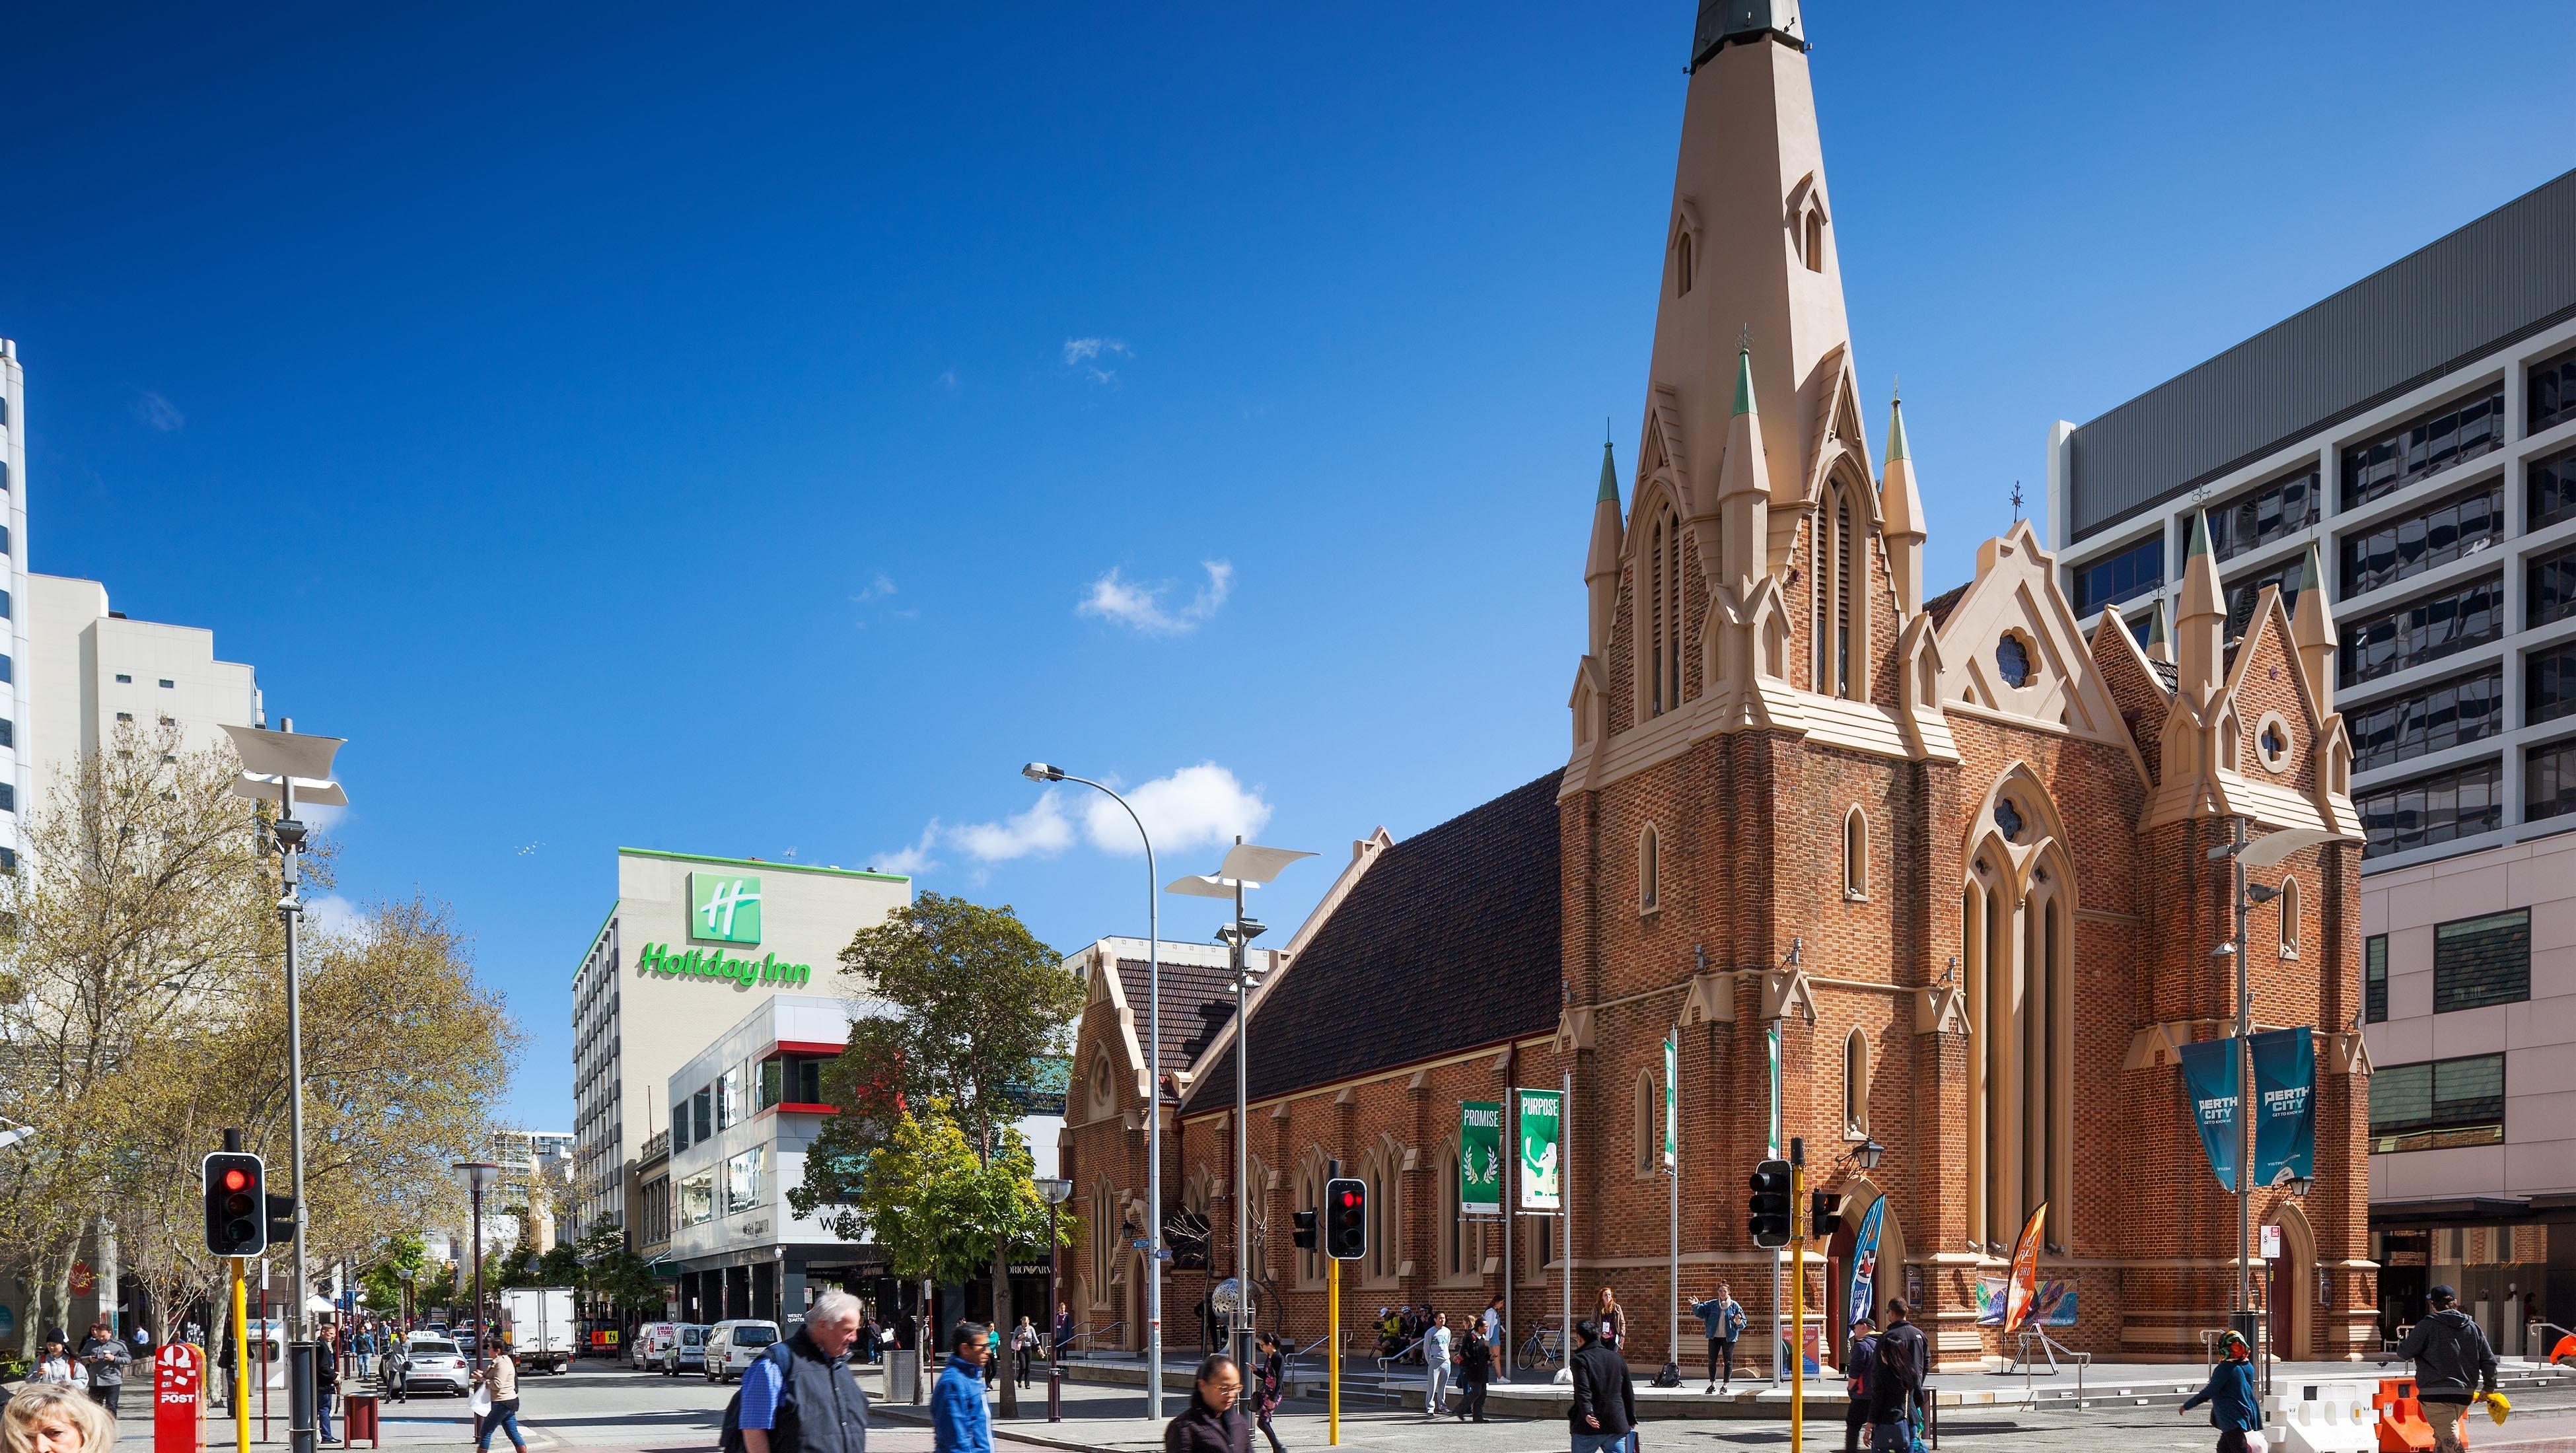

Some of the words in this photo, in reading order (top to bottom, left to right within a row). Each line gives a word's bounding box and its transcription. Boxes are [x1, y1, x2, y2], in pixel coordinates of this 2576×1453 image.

[641, 942, 760, 986] Holiday
[765, 952, 810, 983] Inn
[2199, 1096, 2238, 1114] PERTH
[2264, 1086, 2310, 1106] PERTH
[2272, 1098, 2305, 1112] CITY
[1522, 1097, 1557, 1116] PURPOSE
[2205, 1108, 2232, 1119] CITY
[1464, 1109, 1499, 1127] PROMISE
[161, 1394, 195, 1403] POST
